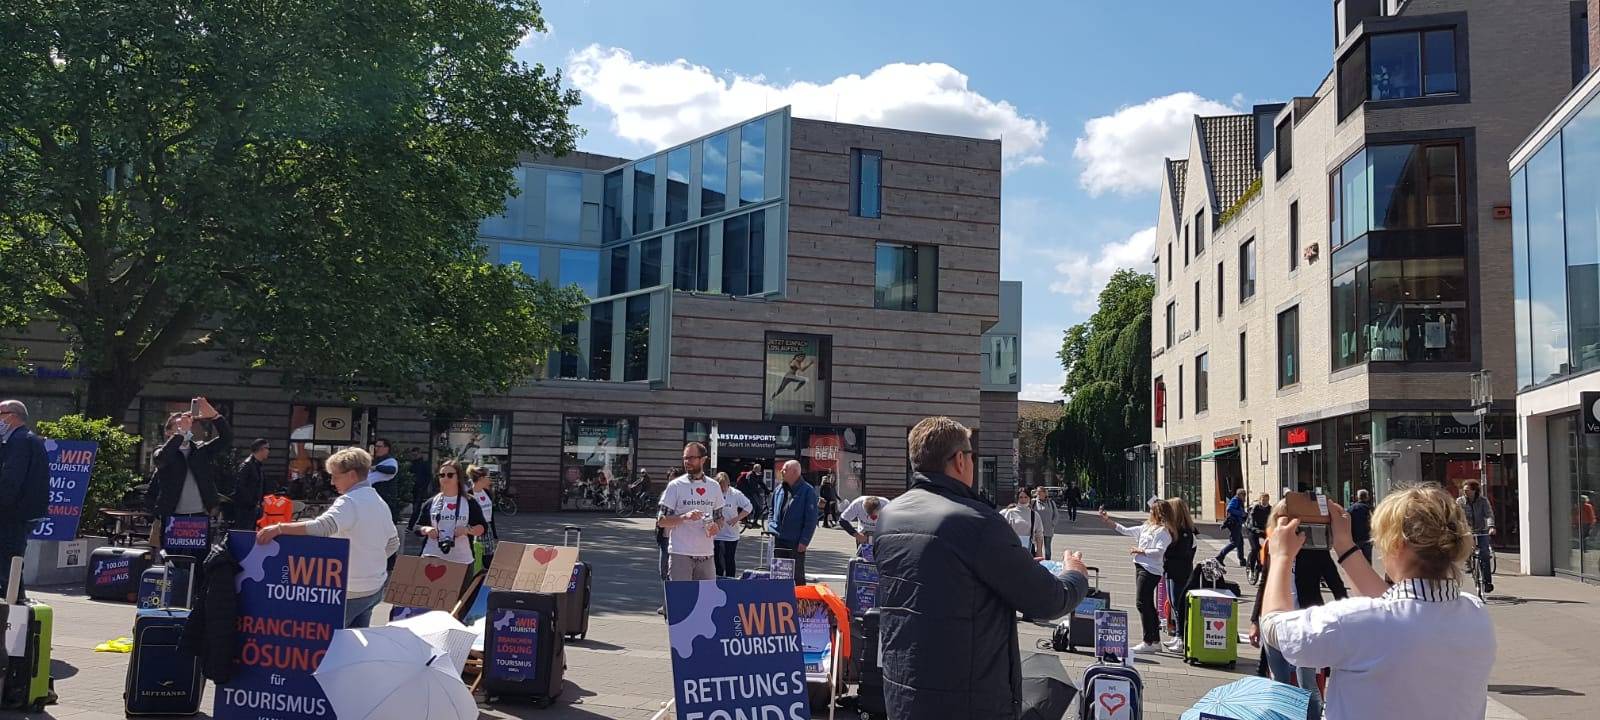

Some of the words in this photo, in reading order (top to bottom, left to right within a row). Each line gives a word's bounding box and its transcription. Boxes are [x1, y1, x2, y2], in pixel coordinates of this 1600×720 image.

[710, 433, 748, 441] ARSTADT
[61, 449, 93, 464] WIR
[815, 452, 837, 460] DEAL
[49, 462, 90, 472] OURISTIK
[167, 537, 206, 546] TOURISMUS
[281, 565, 289, 584] SIND
[288, 555, 343, 588] WIR
[266, 583, 342, 605] TOURISTIK
[738, 602, 798, 636] WIR
[1206, 621, 1211, 630] I
[734, 615, 743, 637] SIND
[1098, 634, 1126, 642] FONDS
[720, 635, 799, 657] TOURISTIK
[495, 658, 532, 668] TOURISMUS
[270, 674, 286, 686] für
[224, 688, 326, 716] TOURISMUS
